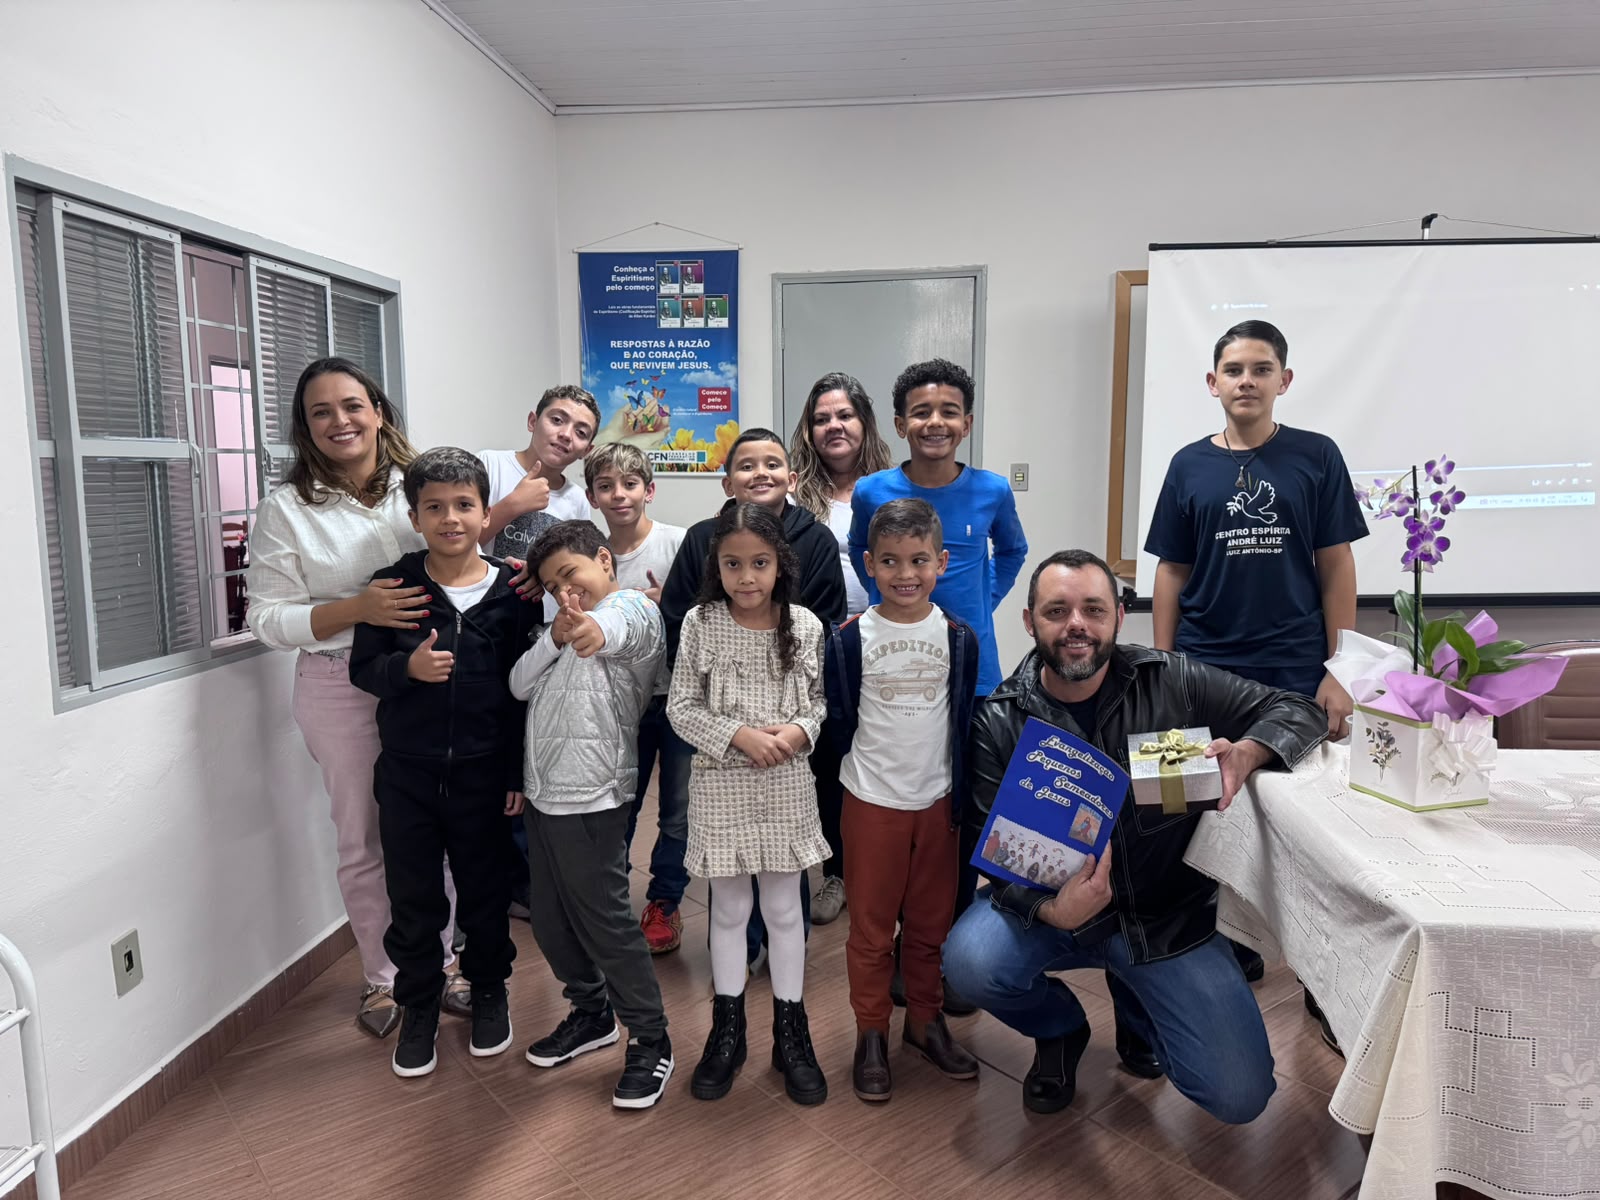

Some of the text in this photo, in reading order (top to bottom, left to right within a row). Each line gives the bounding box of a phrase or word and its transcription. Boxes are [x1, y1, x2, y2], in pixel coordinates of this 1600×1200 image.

[614, 266, 648, 274] Conheça
[612, 275, 654, 283] Espiritismo
[606, 284, 622, 292] pelo
[624, 285, 655, 293] começo
[677, 339, 711, 348] RAZÃO
[648, 350, 698, 360] CORAÇÃO,
[610, 361, 712, 370] QUE REVIVEM JESUS.
[647, 452, 668, 461] CFN
[1215, 526, 1291, 540] CENTRO ESPÍRITA
[1227, 536, 1283, 547] ANDRÉ LUIZ
[1039, 735, 1115, 782] Evangelização
[1026, 750, 1082, 779] Pequenos
[1019, 777, 1071, 807] de Jesus
[1053, 776, 1114, 819] Semeadores
